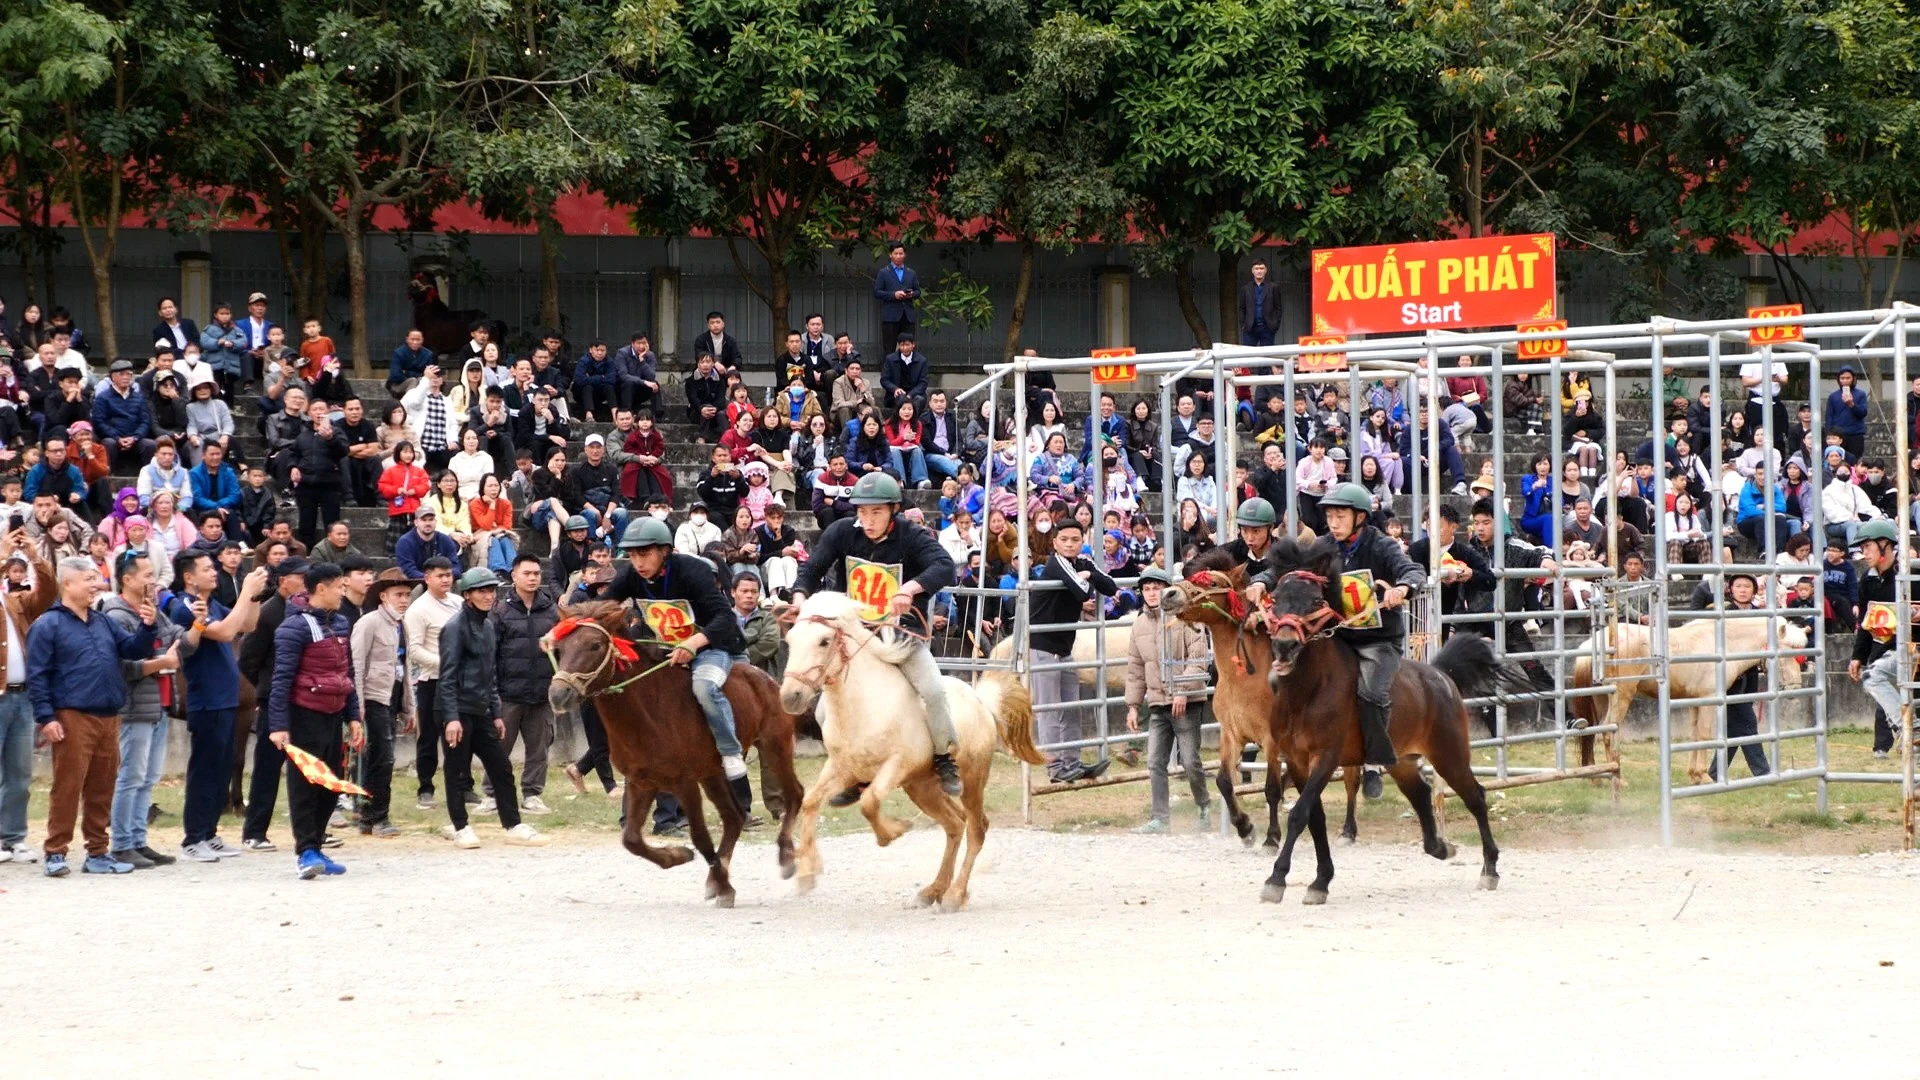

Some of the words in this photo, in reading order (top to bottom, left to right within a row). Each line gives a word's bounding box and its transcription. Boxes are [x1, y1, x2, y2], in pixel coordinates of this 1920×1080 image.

[1327, 248, 1426, 302] XUẤT
[1438, 245, 1540, 295] PHÁT
[1401, 301, 1462, 325] Start
[1756, 310, 1797, 340] 04
[1305, 339, 1342, 367] 02
[1524, 325, 1562, 354] 03
[1098, 352, 1130, 379] 01
[852, 567, 889, 615] 34
